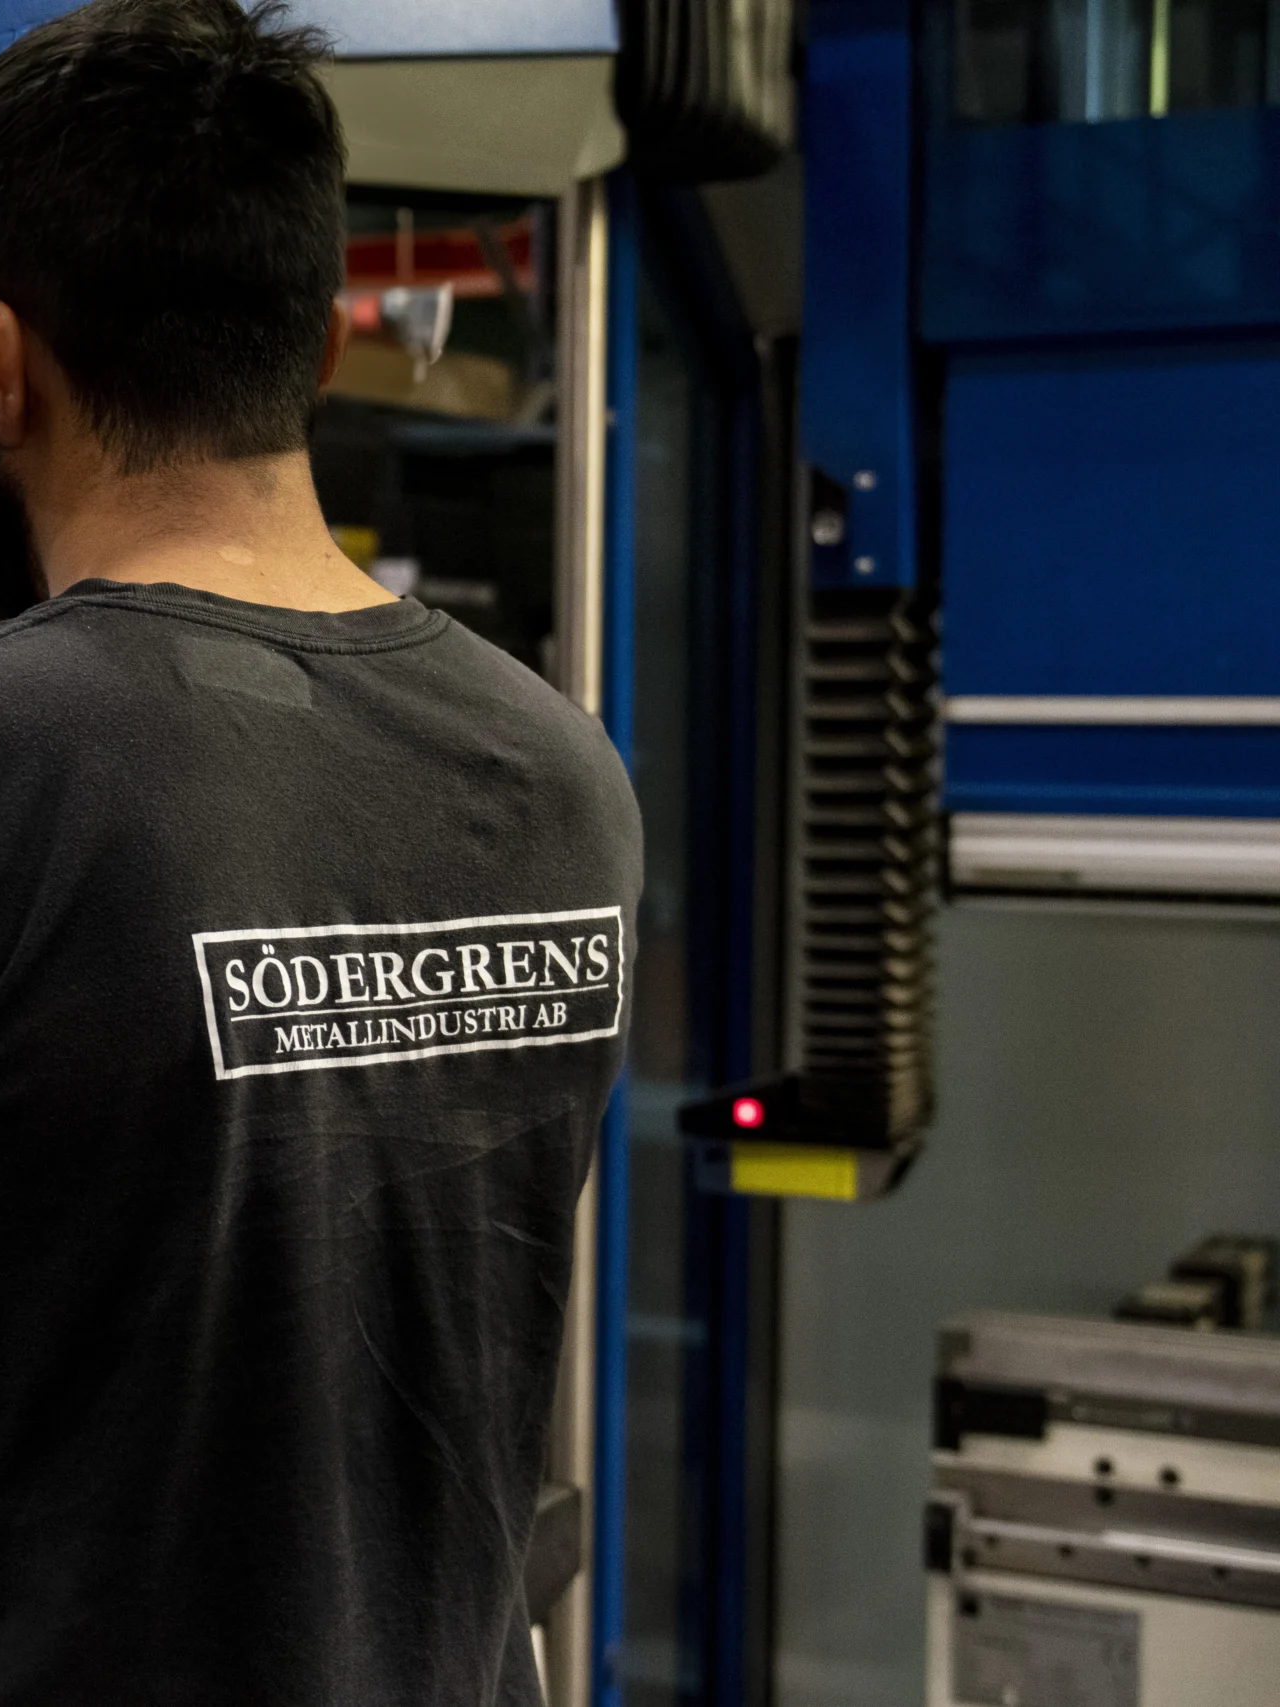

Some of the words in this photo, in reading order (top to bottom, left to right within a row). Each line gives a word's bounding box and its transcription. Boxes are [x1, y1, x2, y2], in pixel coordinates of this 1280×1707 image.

[224, 934, 609, 1011] SÖDERGRENS
[275, 1005, 527, 1054] METALLINDUSTRI
[534, 1003, 568, 1030] AB
